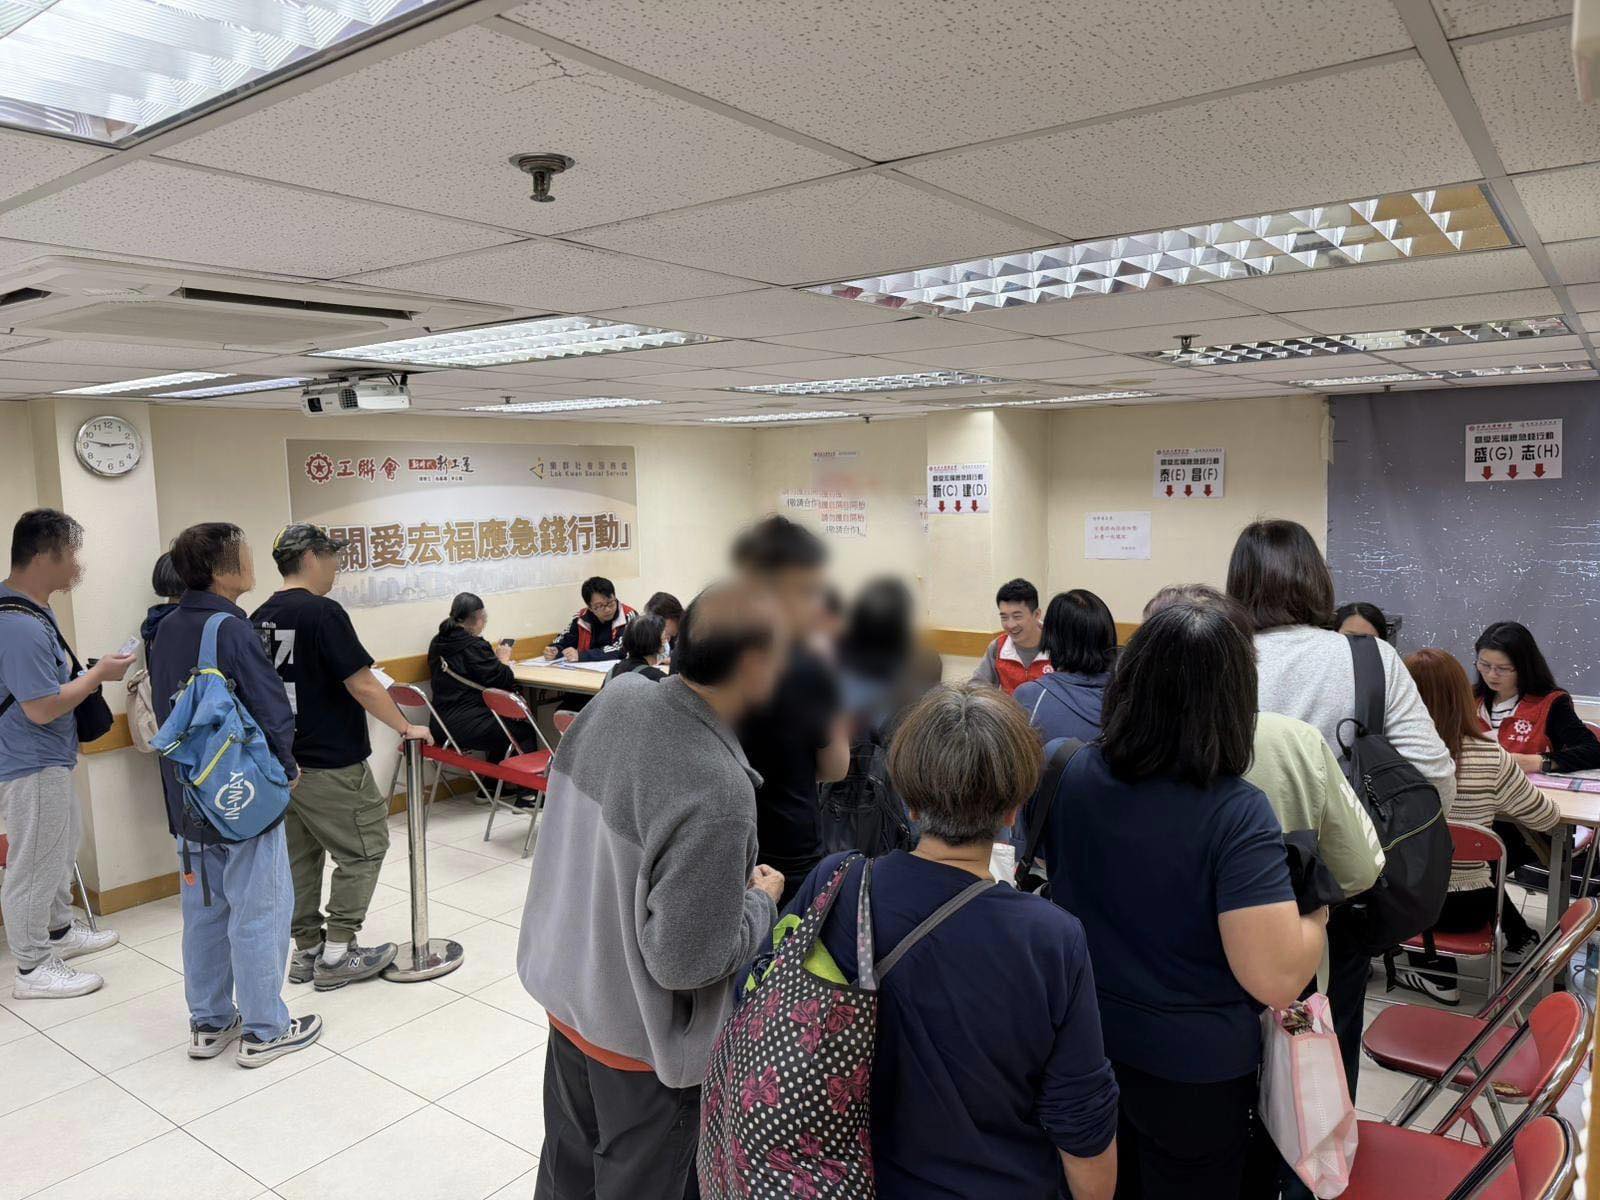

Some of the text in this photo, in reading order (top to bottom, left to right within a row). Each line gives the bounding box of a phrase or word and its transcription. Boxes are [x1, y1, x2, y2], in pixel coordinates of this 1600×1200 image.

[104, 421, 112, 429] 12
[1474, 443, 1560, 463] 盛(G) 志(H)
[337, 456, 400, 481] 工聯會
[1192, 468, 1217, 482] 昌(F)
[933, 484, 958, 497] 新(C)
[320, 513, 631, 571] 關愛宏福應急錢行動」
[224, 771, 244, 820] IN-WAY
